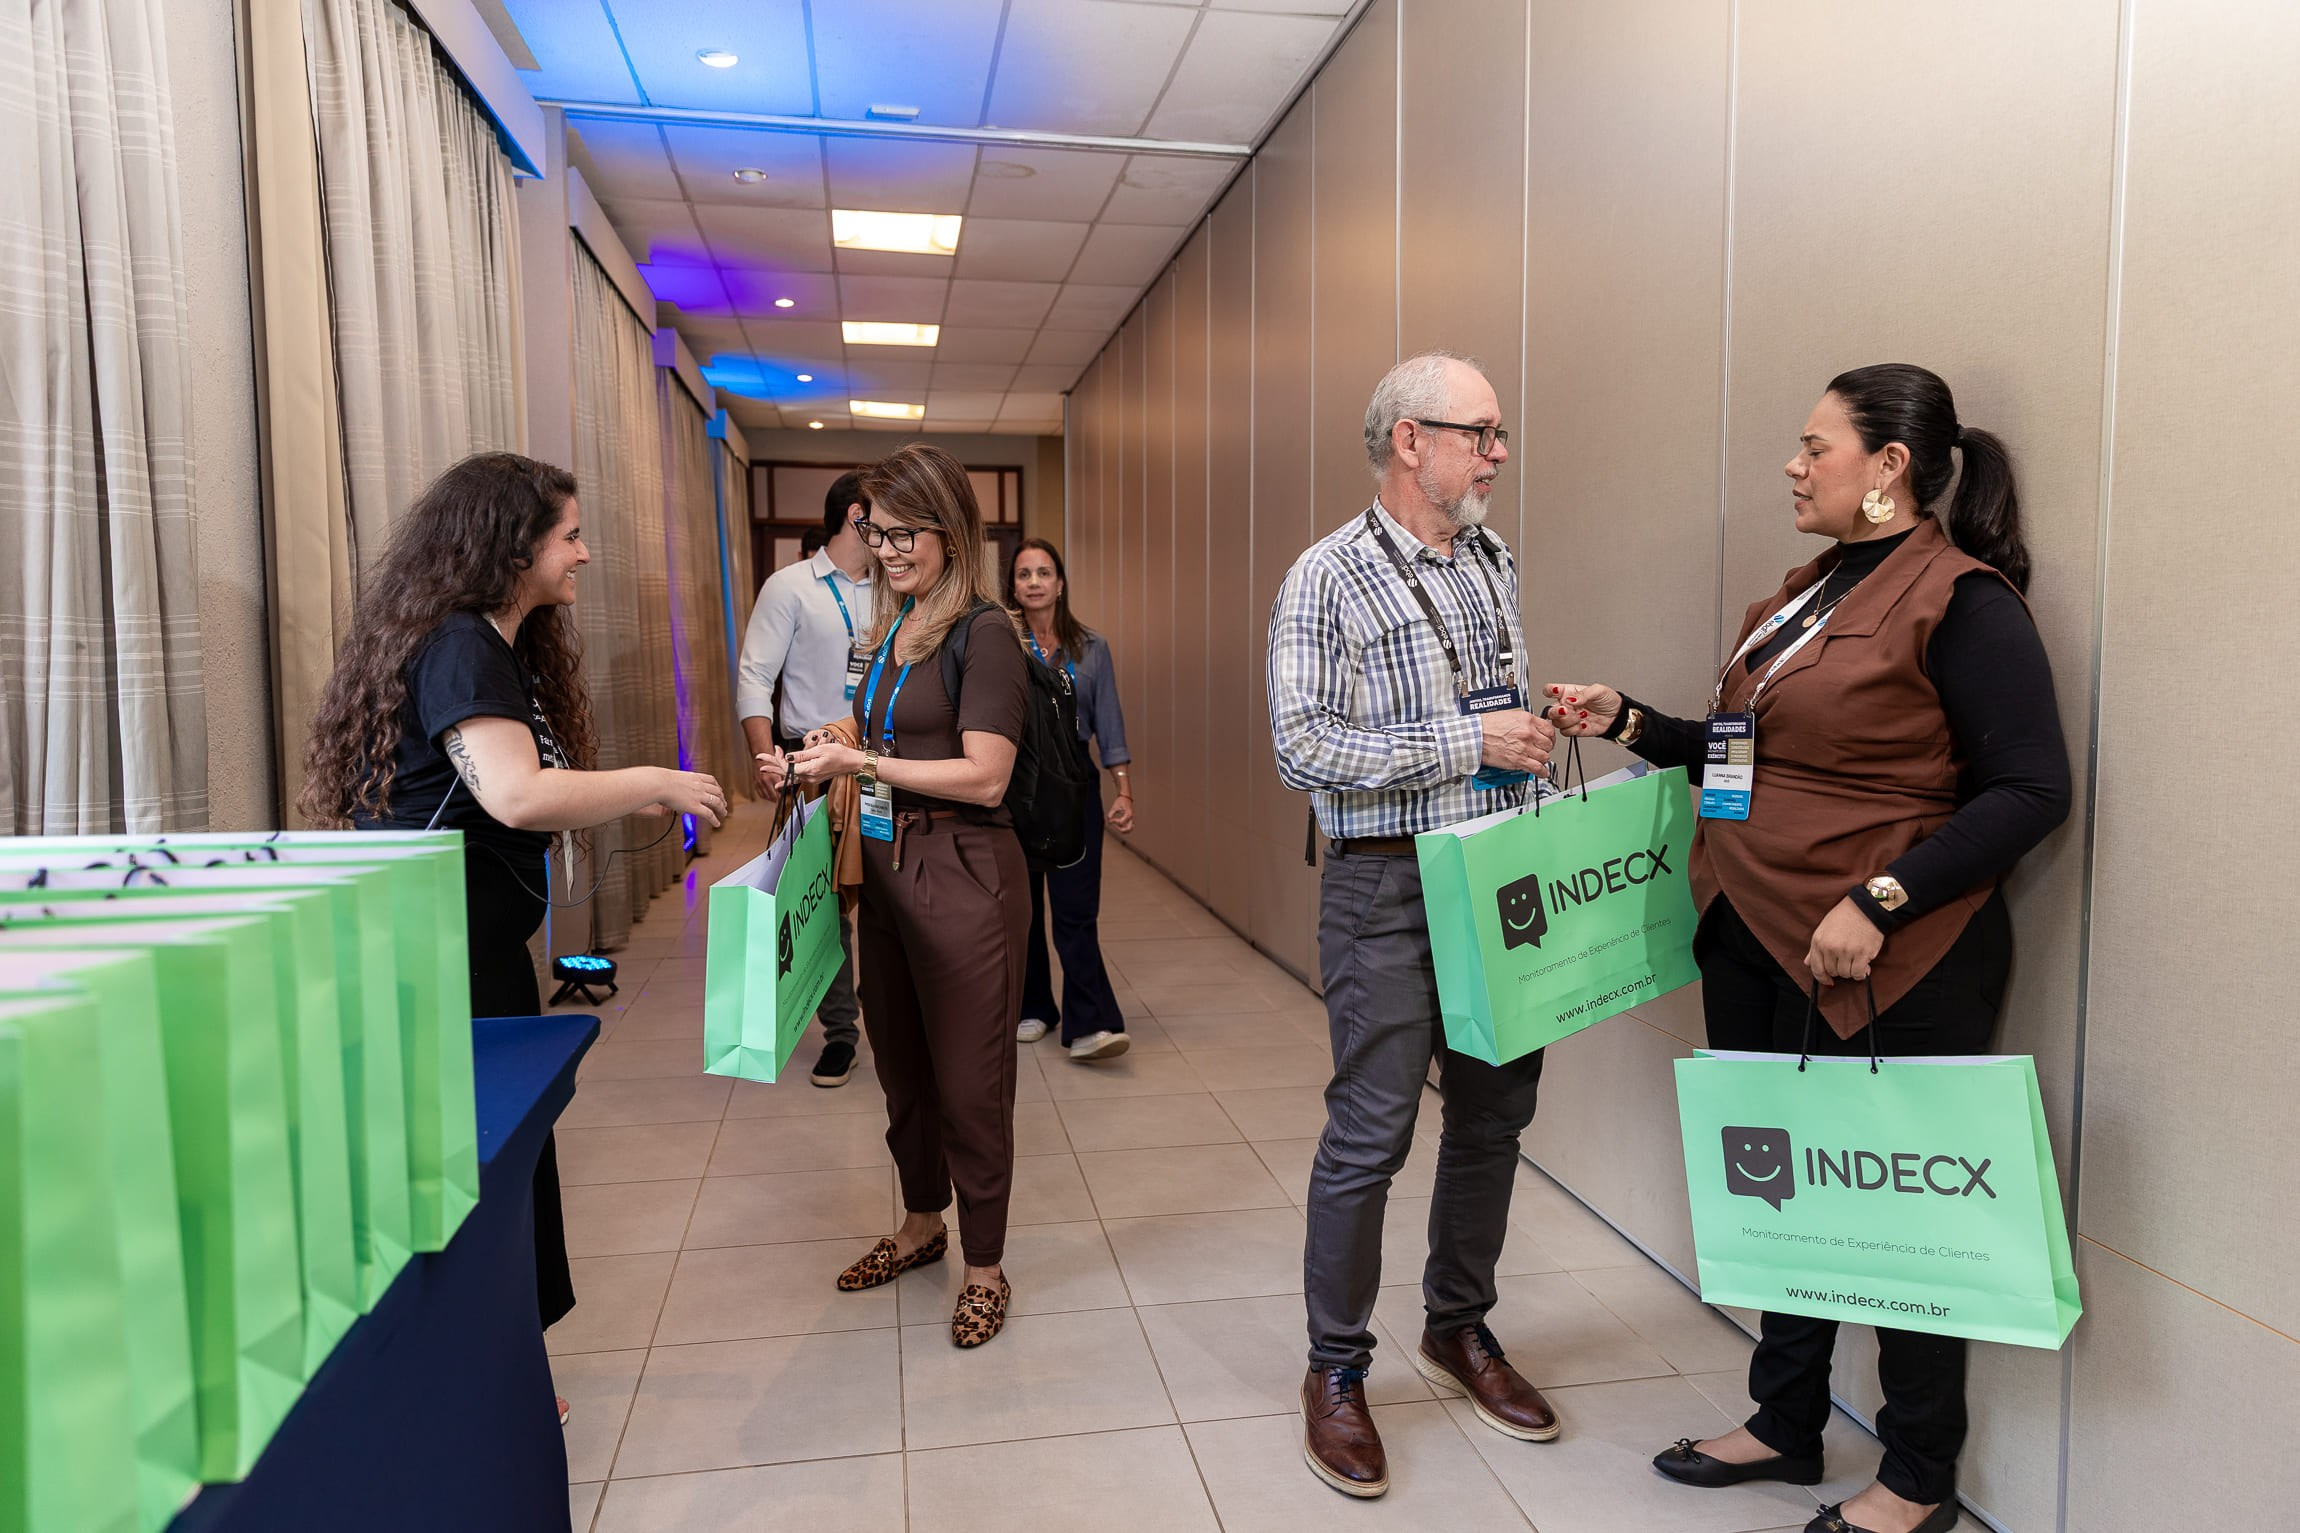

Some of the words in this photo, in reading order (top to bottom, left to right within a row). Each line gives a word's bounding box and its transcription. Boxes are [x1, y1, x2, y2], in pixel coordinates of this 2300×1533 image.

[1469, 697, 1512, 711] REALIDADES
[1707, 740, 1727, 750] VOCÊ
[793, 862, 830, 940] INDECX
[1548, 844, 1672, 915] INDECX
[1518, 955, 1577, 985] Monitoramento
[1577, 950, 1588, 960] de
[1588, 934, 1630, 956] Experiência
[1630, 928, 1640, 938] de
[1641, 917, 1672, 934] Clientes
[1556, 972, 1657, 1023] www.indecx.com.br
[1805, 1147, 1997, 1199] INDECX
[1742, 1226, 1827, 1246] Monitoramento
[1829, 1236, 1845, 1247] de
[1847, 1237, 1916, 1254] Experiência
[1919, 1244, 1936, 1256] de
[1938, 1246, 1990, 1262] Clientes
[1785, 1287, 1951, 1317] www.indecx.com.br
